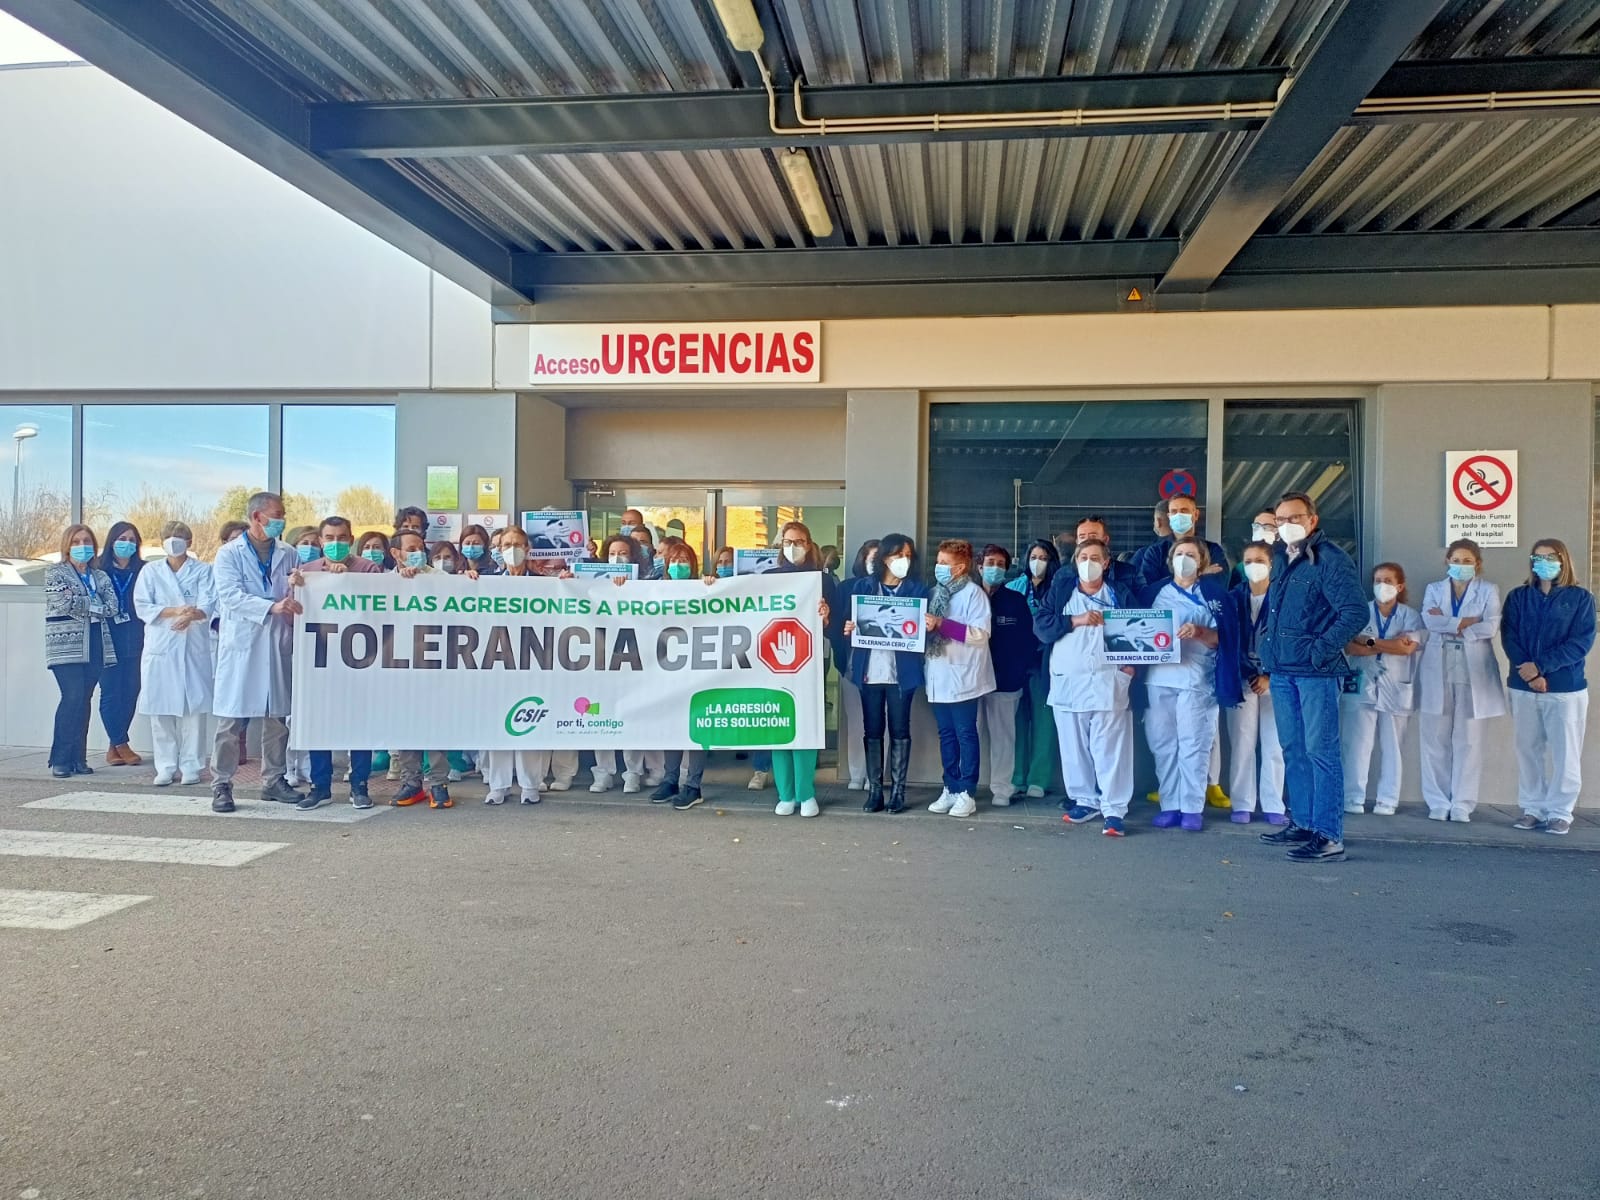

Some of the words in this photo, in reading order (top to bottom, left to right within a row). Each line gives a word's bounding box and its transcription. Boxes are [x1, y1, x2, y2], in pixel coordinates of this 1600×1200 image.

[534, 353, 600, 375] Acceso
[601, 332, 814, 375] URGENCIAS
[322, 593, 387, 612] ANTE
[394, 595, 437, 613] LAS
[443, 596, 591, 615] AGRESIONES
[596, 600, 613, 616] A
[618, 594, 797, 616] PROFESIONALES
[305, 623, 643, 672] TOLERANCIA
[858, 639, 891, 647] TOLERANCIA
[891, 640, 906, 648] CERO
[705, 703, 723, 716] ¡LA
[725, 701, 780, 714] AGRESIÓN
[556, 720, 574, 729] por
[576, 718, 585, 728] ti,
[587, 718, 624, 729] contigo
[696, 717, 712, 728] NO
[714, 717, 728, 728] ES
[730, 715, 790, 728] SOLUCIÓN!
